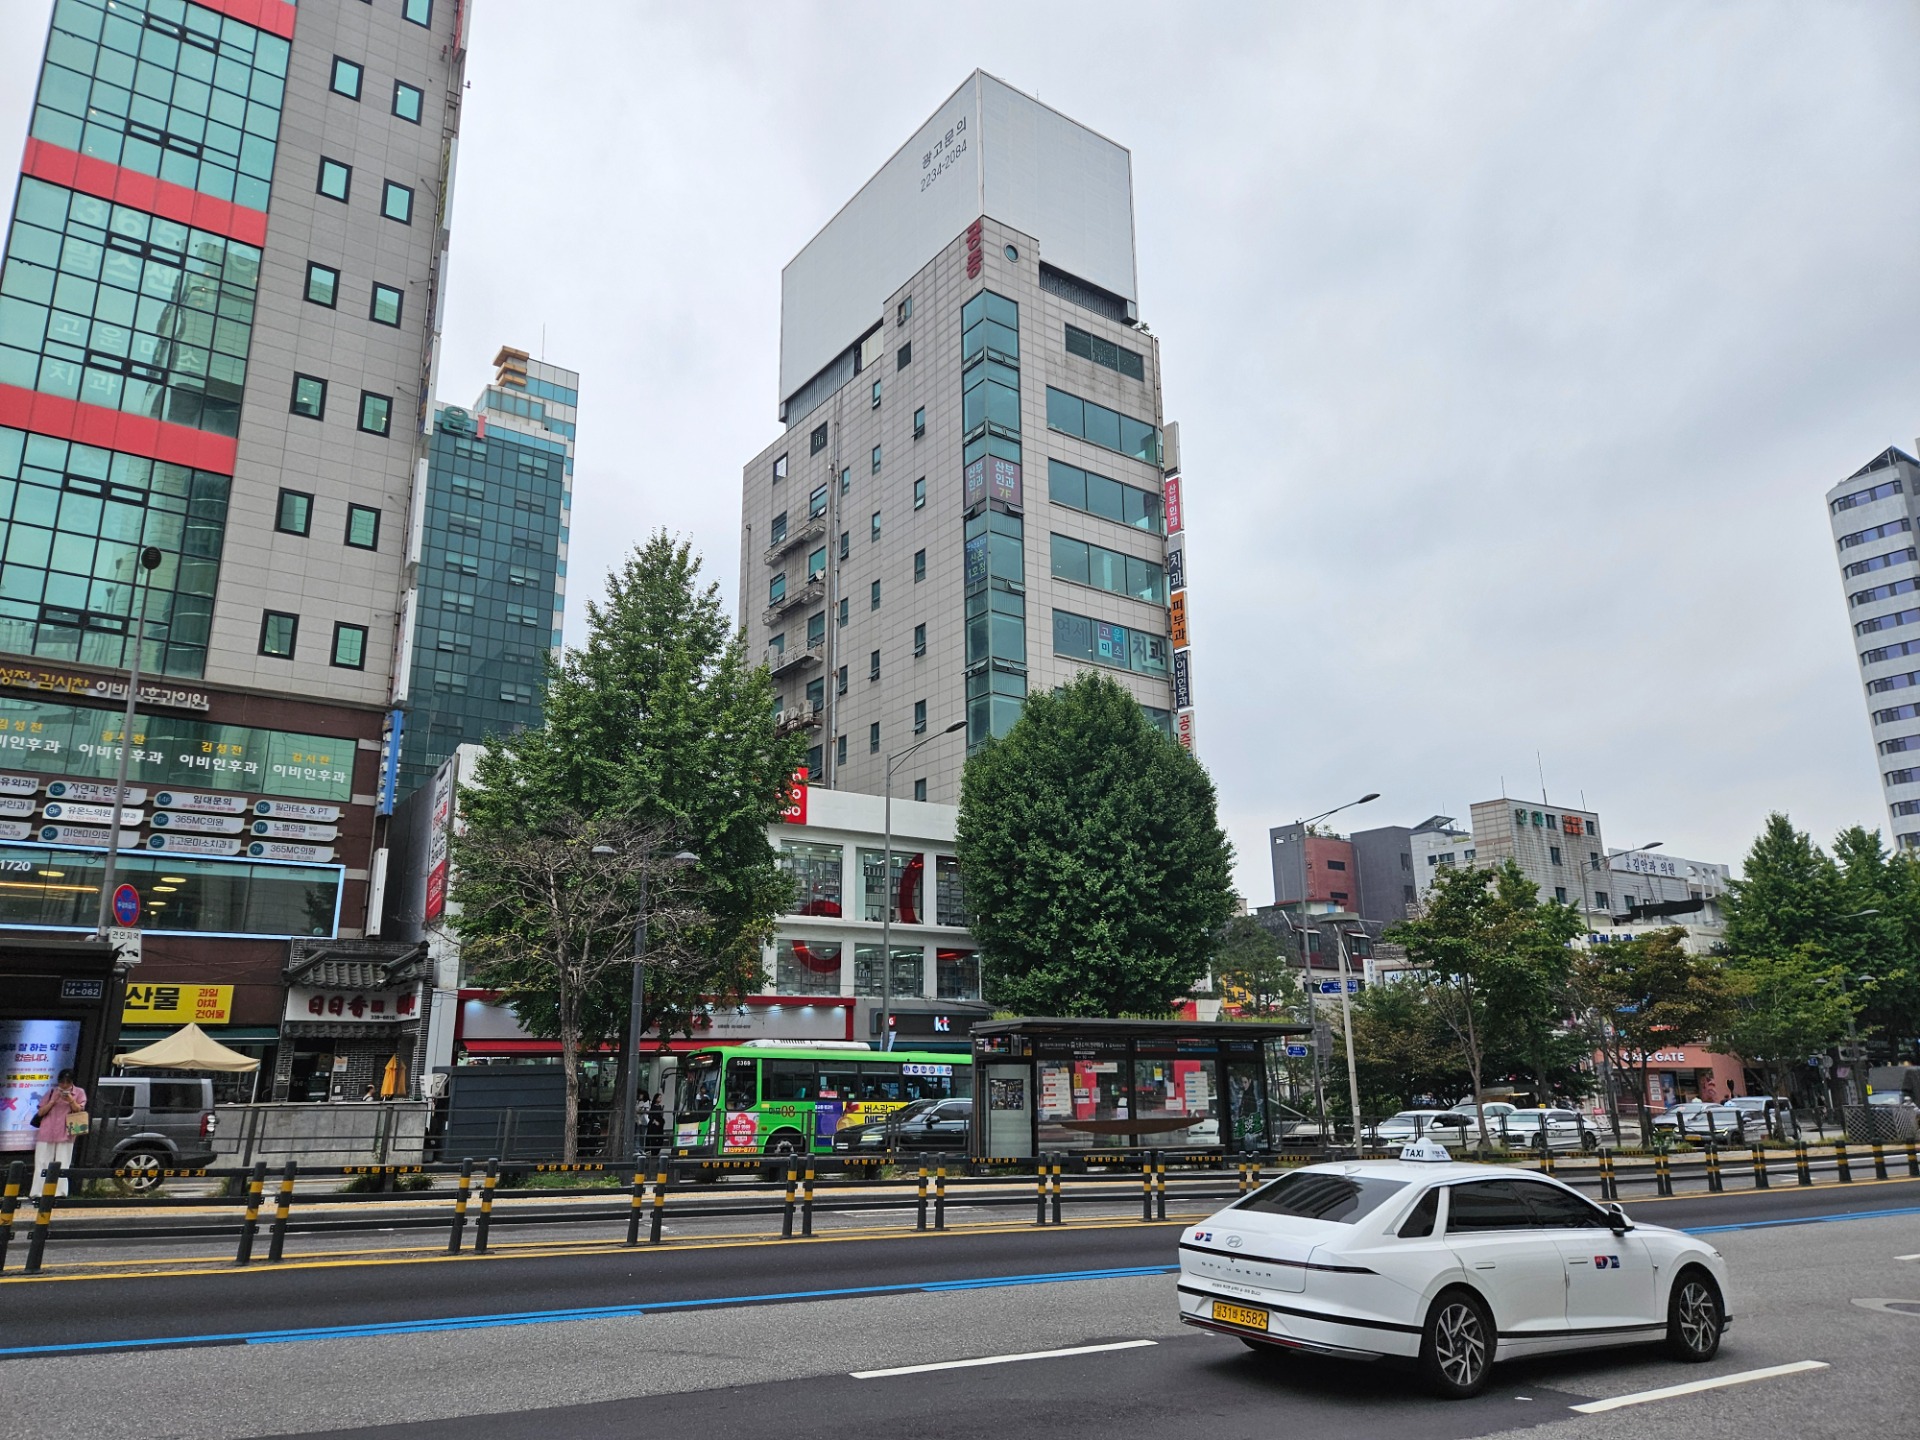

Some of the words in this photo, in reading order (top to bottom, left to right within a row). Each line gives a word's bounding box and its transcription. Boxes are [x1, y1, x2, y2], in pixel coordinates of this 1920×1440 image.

[922, 116, 967, 170] 광고문의
[920, 139, 967, 192] 2234-2084
[49, 361, 118, 395] 치과
[968, 462, 984, 479] 산부
[995, 461, 1015, 475] 산부
[995, 474, 1015, 489] 인과
[1000, 488, 1012, 499] 7F
[1168, 483, 1178, 527] 산부인과
[1170, 551, 1183, 587] 치과
[1172, 599, 1185, 640] 피부과
[1056, 618, 1089, 646] 연세
[1101, 626, 1121, 642] 고운
[1101, 642, 1123, 656] 미소
[1133, 635, 1167, 666] 치과
[1176, 660, 1188, 706] 이비인후과
[201, 741, 242, 756] 김성전
[179, 754, 259, 775] 이비인후과
[272, 764, 346, 784] 이비인후과
[69, 783, 99, 795] 자연과
[193, 795, 232, 806] 임대문의
[275, 803, 307, 813] 필라테스
[309, 806, 316, 814] &
[174, 815, 224, 827] 365MC의원
[176, 836, 227, 849] 고운미소치과
[270, 845, 316, 855] 365MC의원
[0, 860, 31, 872] 1720
[1633, 857, 1656, 873] 김안과
[1660, 861, 1676, 876] 의원
[112, 930, 139, 940] 견인지역
[124, 986, 180, 1011] 산물
[198, 988, 219, 998] 과일
[197, 999, 217, 1009] 야채
[195, 1009, 225, 1019] 건어물
[934, 1016, 950, 1031] kt
[1655, 1051, 1685, 1062] GATE
[1405, 1148, 1424, 1158] TAXI
[114, 1168, 207, 1178] 무단횡단금지
[343, 1165, 423, 1174] 무단횡단금지
[1239, 1309, 1264, 1327] 5582
